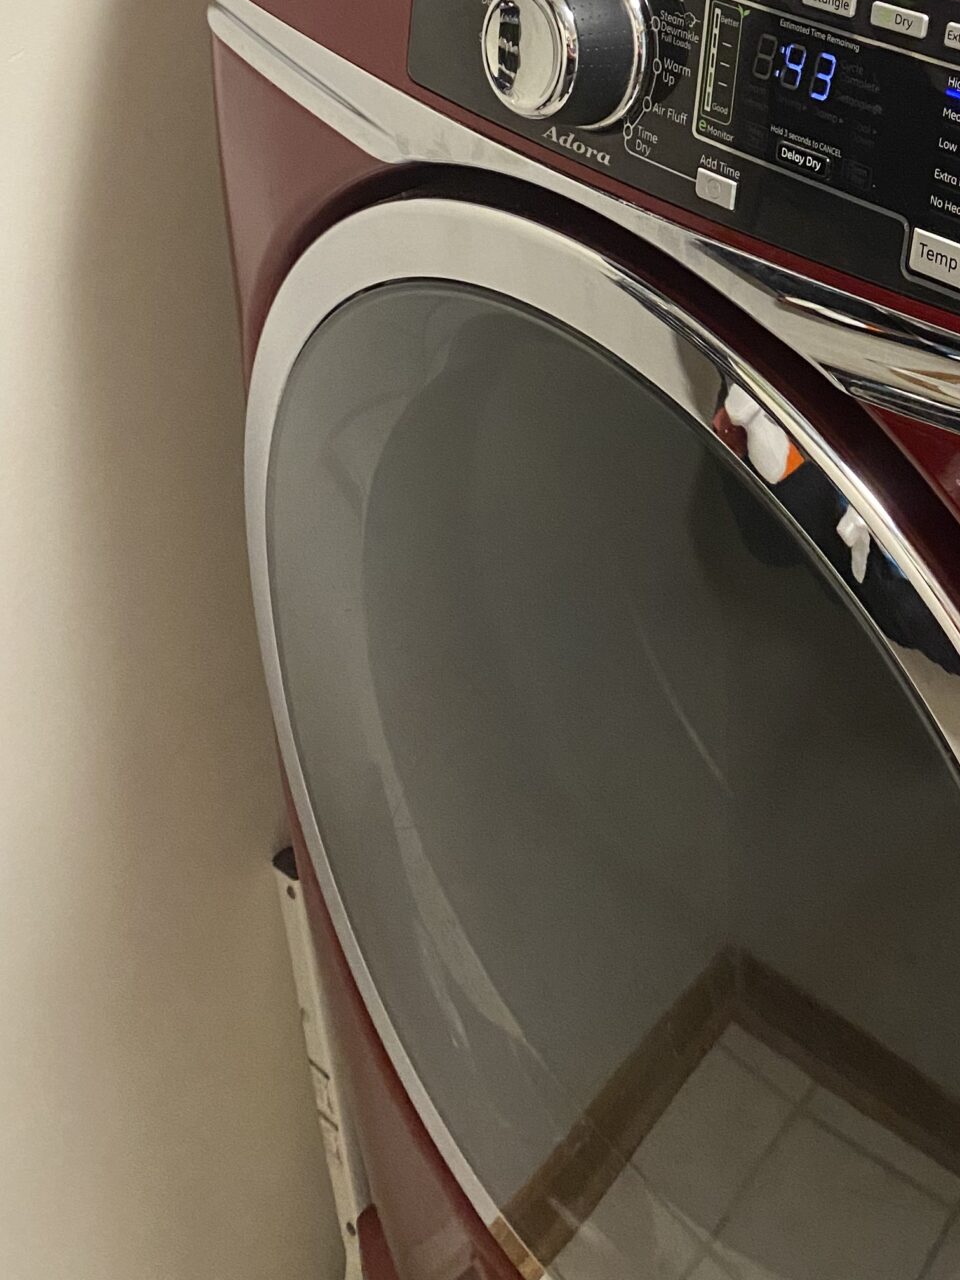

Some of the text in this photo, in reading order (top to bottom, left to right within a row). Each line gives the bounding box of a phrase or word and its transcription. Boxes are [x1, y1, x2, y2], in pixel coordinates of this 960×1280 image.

[659, 10, 685, 28] Steam
[720, 15, 740, 28] Better
[894, 12, 914, 30] Dry
[660, 21, 700, 44] Dewrinkle
[661, 33, 692, 50] Full Loads
[779, 19, 860, 54] Estimated Time Remaining
[664, 57, 691, 77] Warm
[662, 72, 675, 86] Up
[652, 102, 689, 125] Air Fluff
[712, 102, 729, 116] Good
[637, 125, 659, 144] Time
[698, 119, 734, 143] e Monitor
[541, 124, 612, 167] Adora
[635, 140, 652, 157] Dry
[770, 124, 842, 159] Hold 3 seconds to CANCEL
[938, 137, 958, 153] Low
[700, 154, 741, 180] Add Time
[781, 146, 823, 172] Delay Dry
[934, 168, 957, 186] Extra
[930, 195, 943, 209] No
[919, 241, 958, 272] Temp
